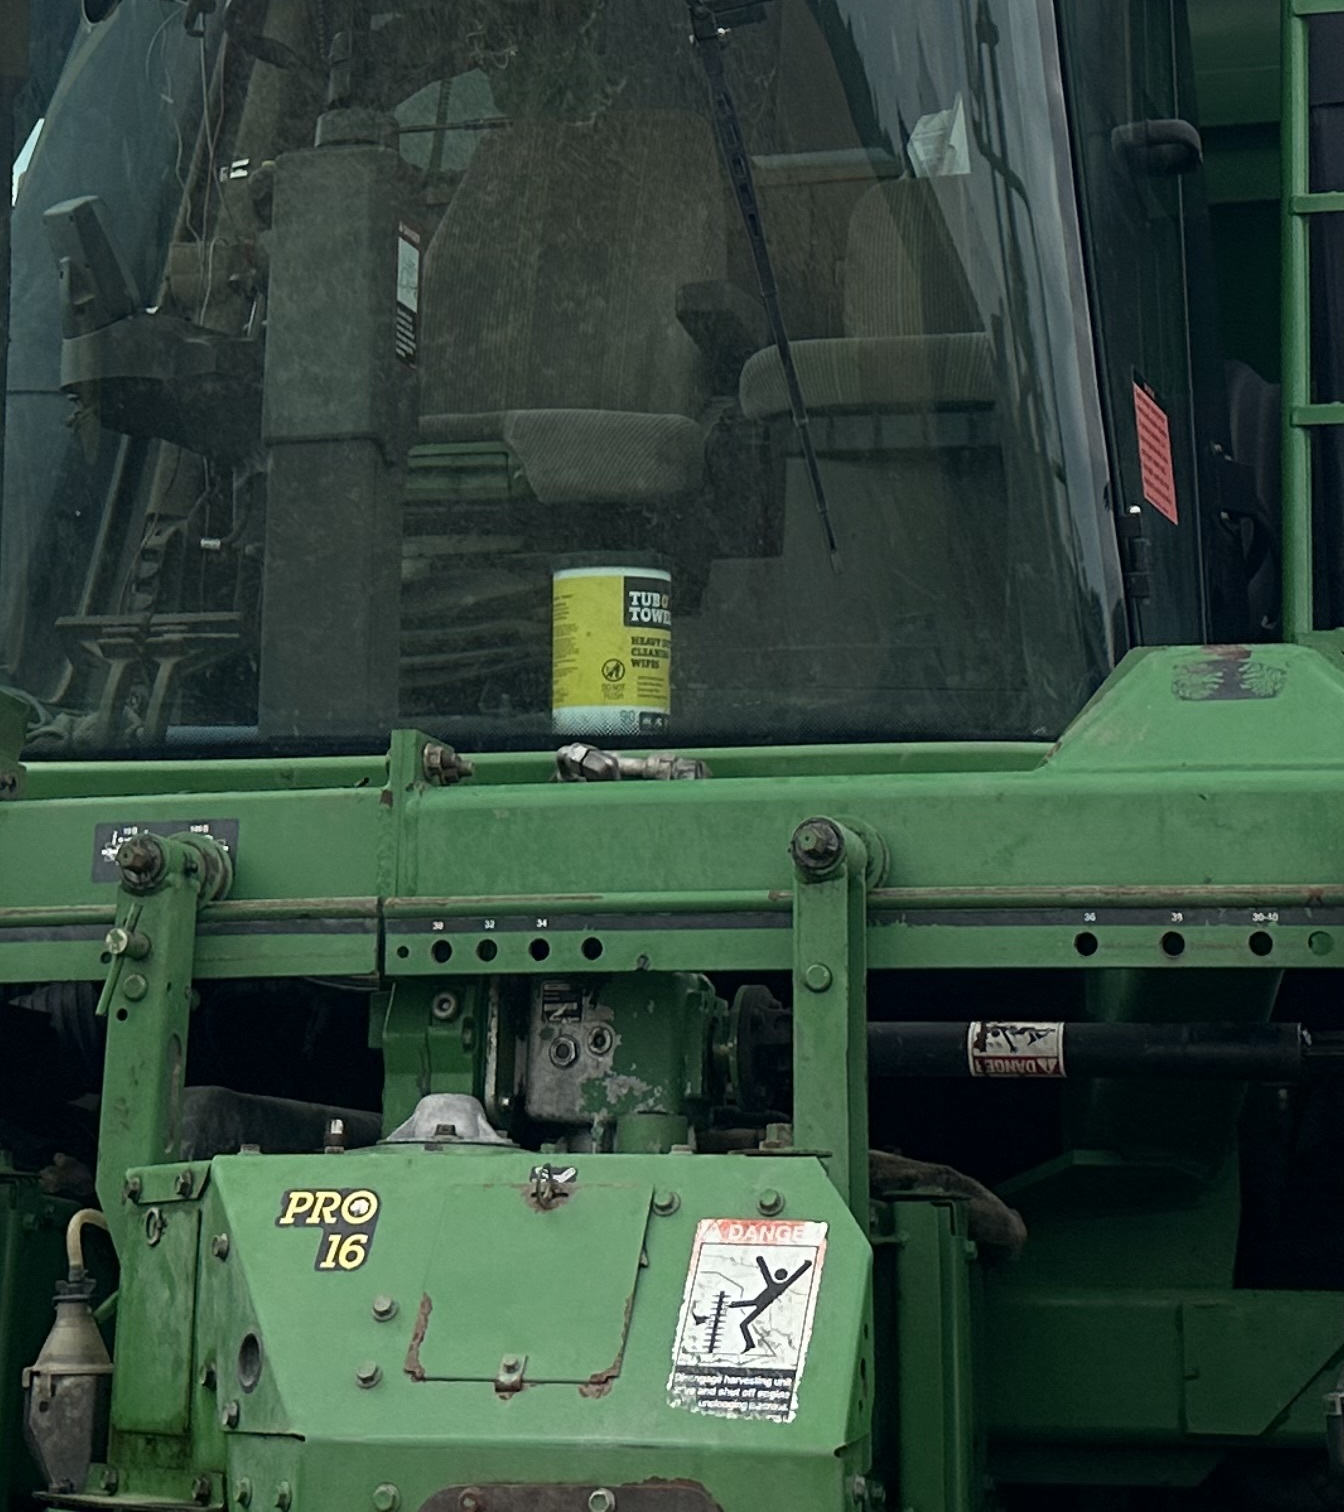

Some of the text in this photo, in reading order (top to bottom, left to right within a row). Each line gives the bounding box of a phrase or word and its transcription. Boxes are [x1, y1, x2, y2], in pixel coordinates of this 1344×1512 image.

[629, 591, 660, 607] TUB
[279, 1190, 378, 1225] PRO
[319, 1233, 369, 1270] 16
[723, 1374, 772, 1388] harvesting
[773, 1376, 793, 1387] unit
[697, 1387, 717, 1397] and
[717, 1387, 741, 1398] shut
[741, 1388, 757, 1398] off
[698, 1400, 747, 1412] unclogging
